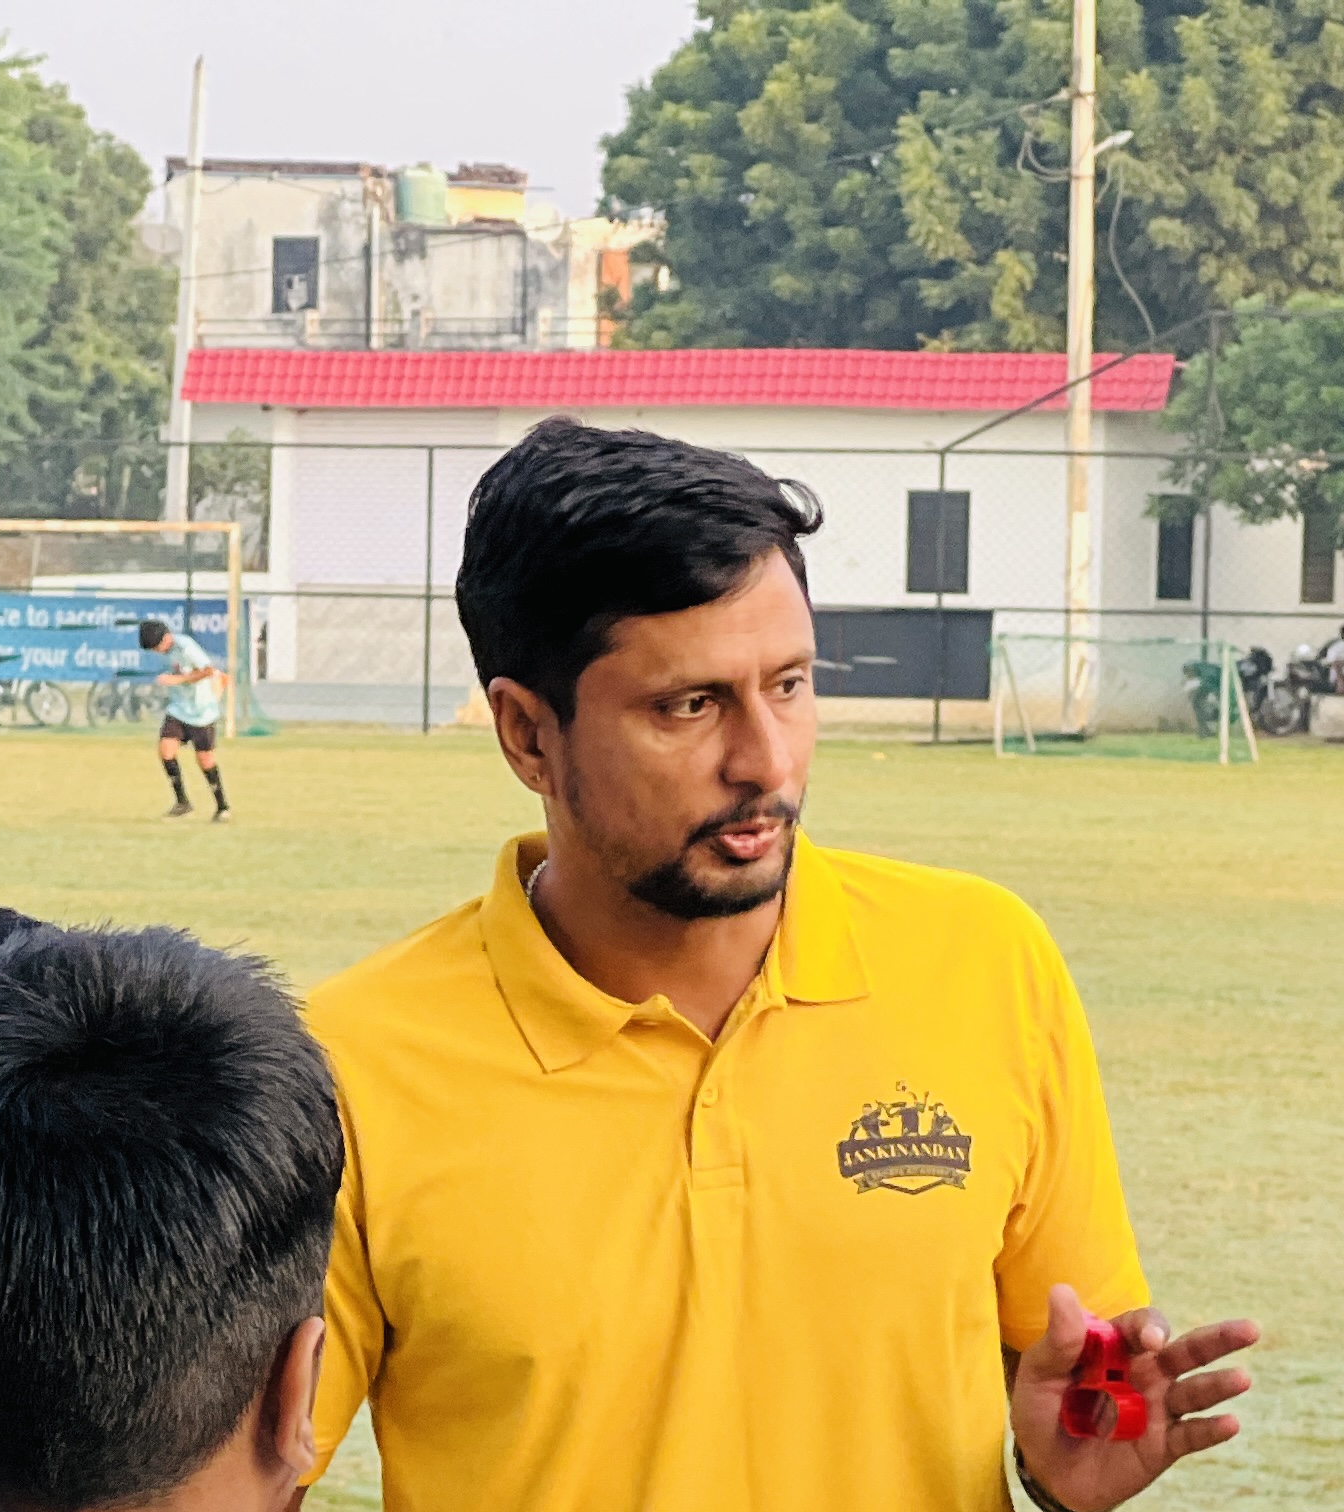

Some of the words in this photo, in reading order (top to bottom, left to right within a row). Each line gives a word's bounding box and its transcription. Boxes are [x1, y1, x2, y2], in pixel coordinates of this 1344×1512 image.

[27, 604, 49, 627] to
[20, 646, 68, 672] your
[74, 643, 141, 669] dream
[843, 1143, 966, 1167] JANKINANDAN
